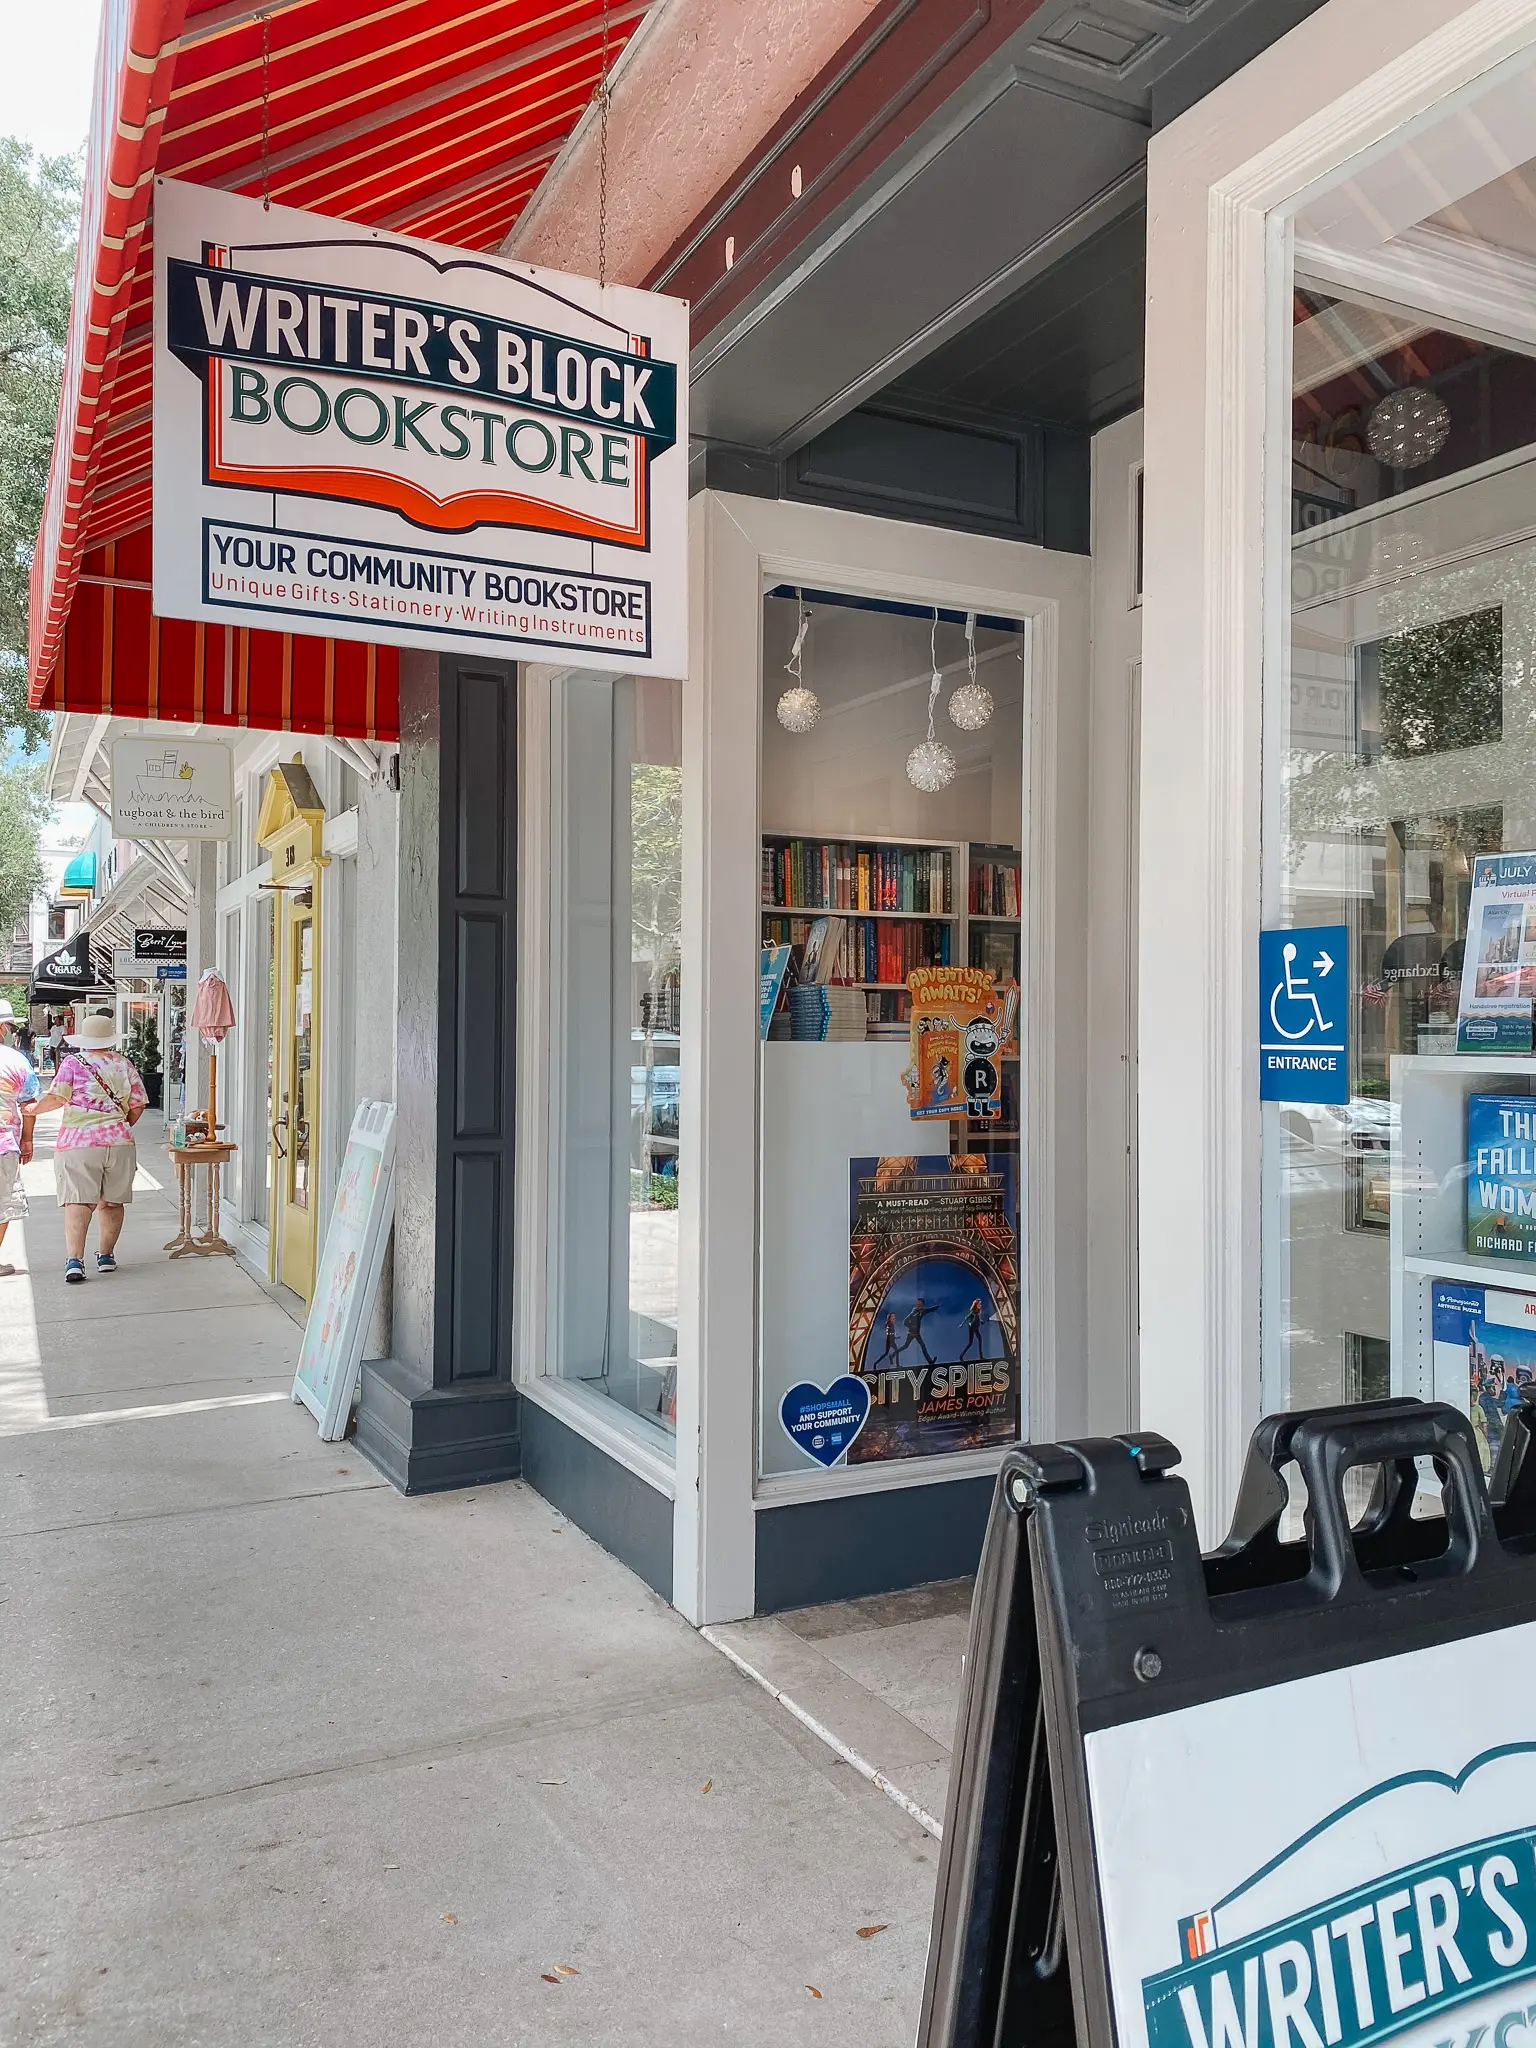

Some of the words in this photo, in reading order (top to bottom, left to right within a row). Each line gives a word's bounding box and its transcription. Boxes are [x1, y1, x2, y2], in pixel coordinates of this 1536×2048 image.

[196, 276, 481, 384] WRITER'S
[497, 323, 655, 429] BLOCK
[229, 364, 631, 488] BOOKSTORE
[212, 572, 286, 600] Unique
[213, 534, 297, 576] YOUR
[307, 548, 477, 598] COMMUNITY
[485, 575, 643, 620] BOOKSTORE
[118, 807, 164, 821] tugboat
[178, 808, 198, 820] the
[200, 808, 225, 821] bird
[1499, 866, 1532, 878] JULY
[1502, 889, 1529, 898] Virtual
[46, 963, 82, 977] CIGARS
[908, 966, 993, 991] ADVENTURE
[920, 984, 982, 1004] AWAITS!
[1267, 1056, 1337, 1071] ENTRANCE
[975, 1070, 988, 1089] R
[1499, 1110, 1536, 1140] TH
[1477, 1148, 1536, 1176] FALL
[969, 1195, 992, 1204] GIBBS
[1476, 1235, 1523, 1252] RICHARD
[861, 1368, 929, 1406] CITY
[930, 1360, 1010, 1398] SPIES
[799, 1399, 852, 1413] #SHOPSMALL
[917, 1397, 963, 1414] JAMES
[966, 1393, 1007, 1408] PONTI
[791, 1422, 813, 1433] YOUR
[813, 1414, 861, 1429] COMMUNITY
[799, 1413, 816, 1423] AND
[817, 1407, 853, 1419] SUPPORT
[918, 1414, 937, 1423] Edgar
[937, 1410, 984, 1420] Award-Winning
[985, 1407, 1006, 1415] Author
[1178, 1854, 1528, 2048] WRITER'S
